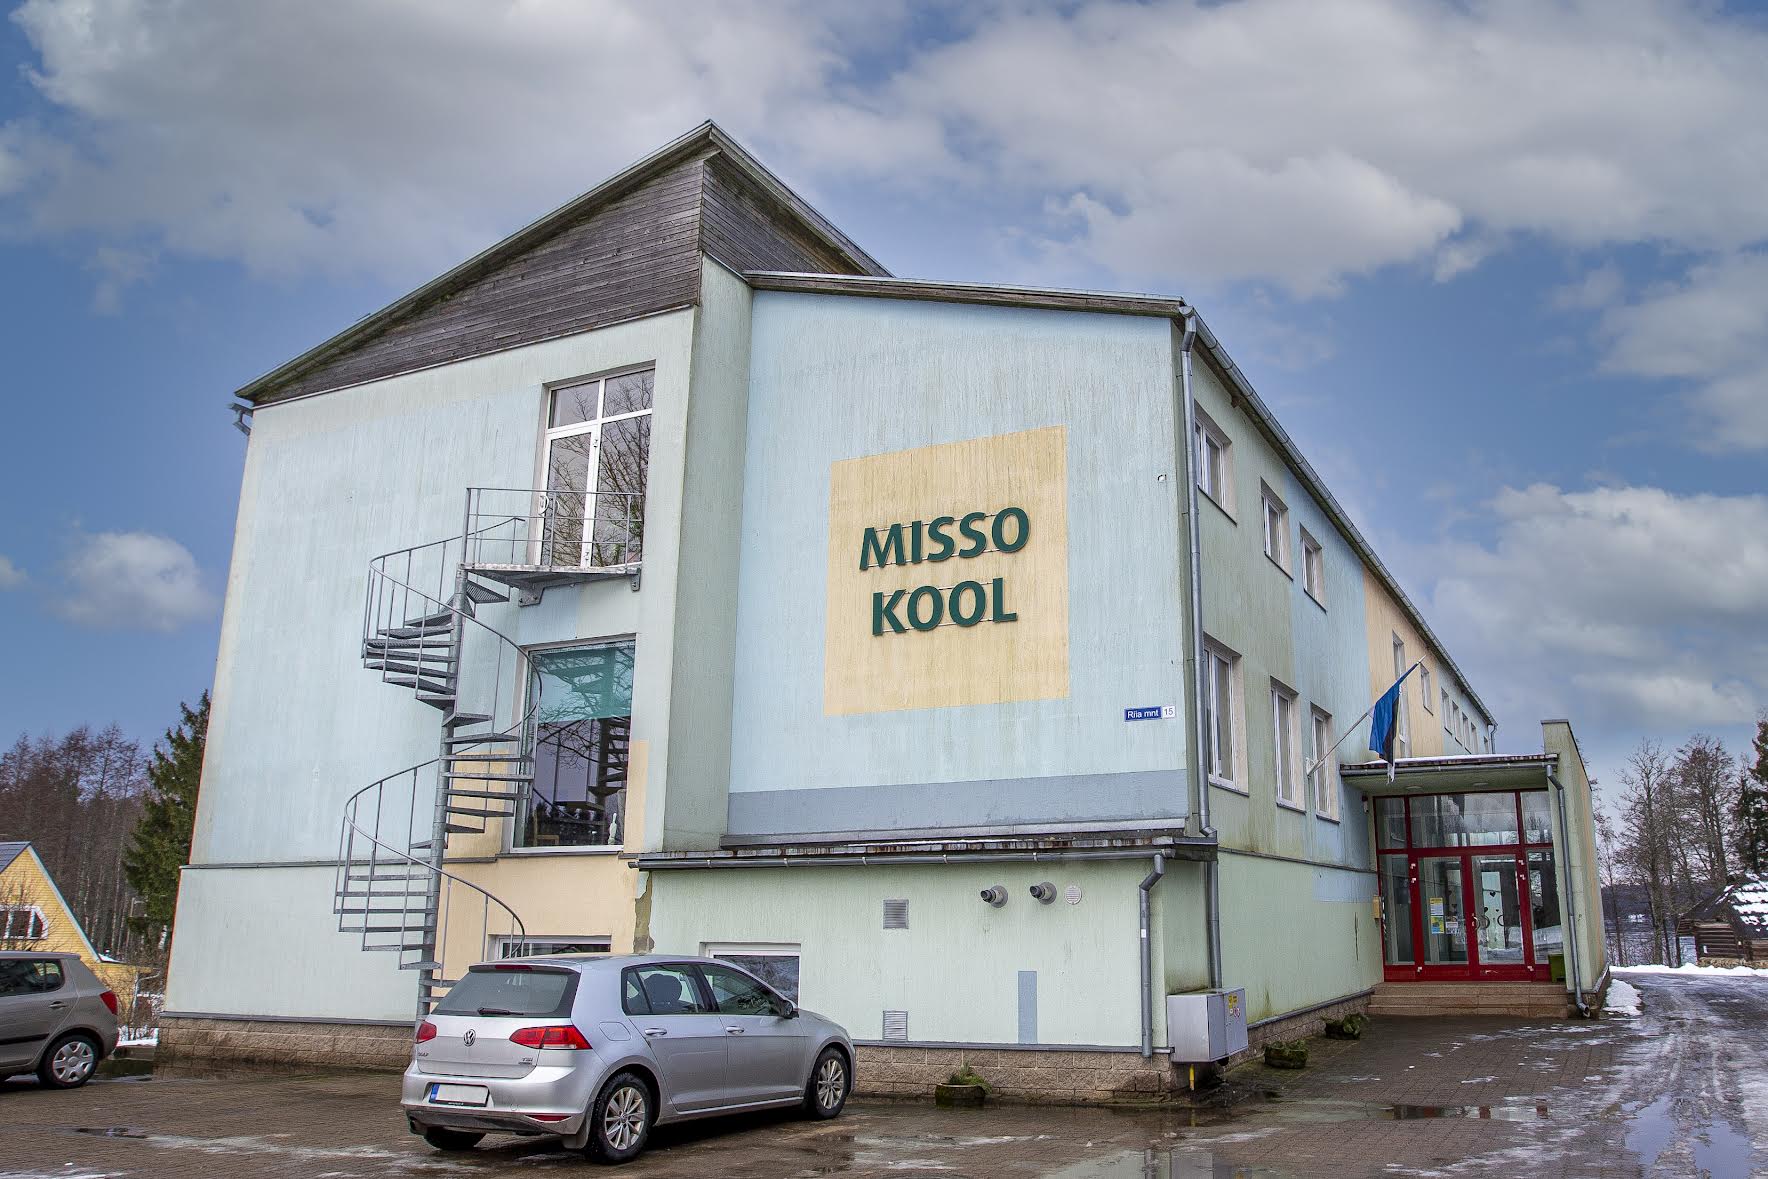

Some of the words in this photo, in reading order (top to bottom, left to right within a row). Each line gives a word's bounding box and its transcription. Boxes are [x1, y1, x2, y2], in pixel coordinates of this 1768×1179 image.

[859, 507, 1029, 571] MISSO
[872, 578, 1018, 636] KOOL
[1127, 710, 1142, 719] Riia
[1144, 709, 1159, 718] mnt
[1164, 707, 1174, 716] 15
